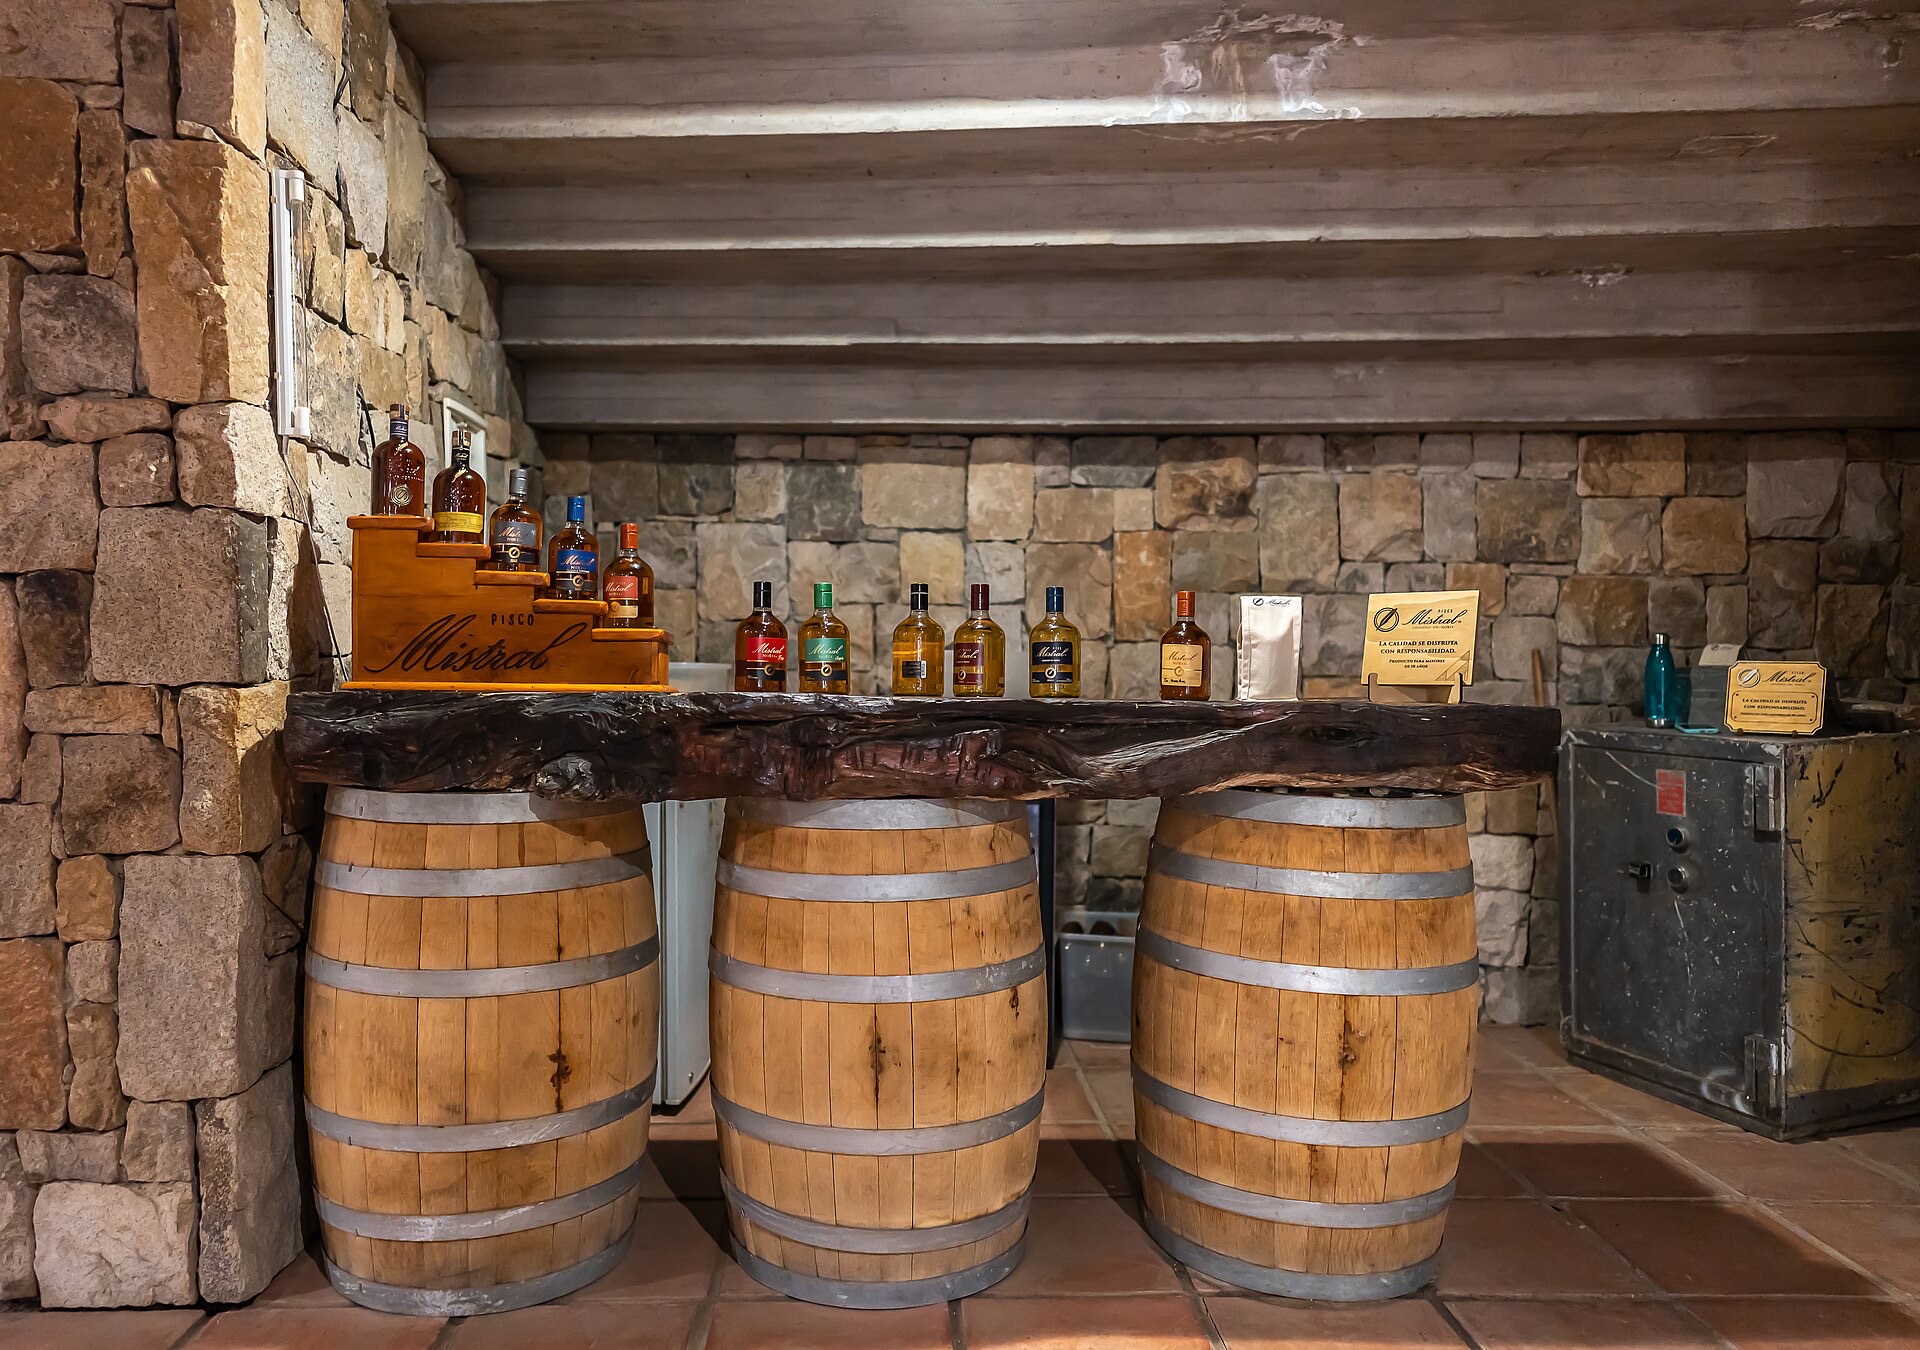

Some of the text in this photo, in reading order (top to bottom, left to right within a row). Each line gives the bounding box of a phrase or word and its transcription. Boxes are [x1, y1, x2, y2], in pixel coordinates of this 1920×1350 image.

[491, 613, 535, 626] PISCO
[1401, 608, 1468, 626] Mistral
[363, 613, 588, 673] Mistral
[751, 642, 785, 654] Mistral
[1035, 646, 1069, 658] Mistral
